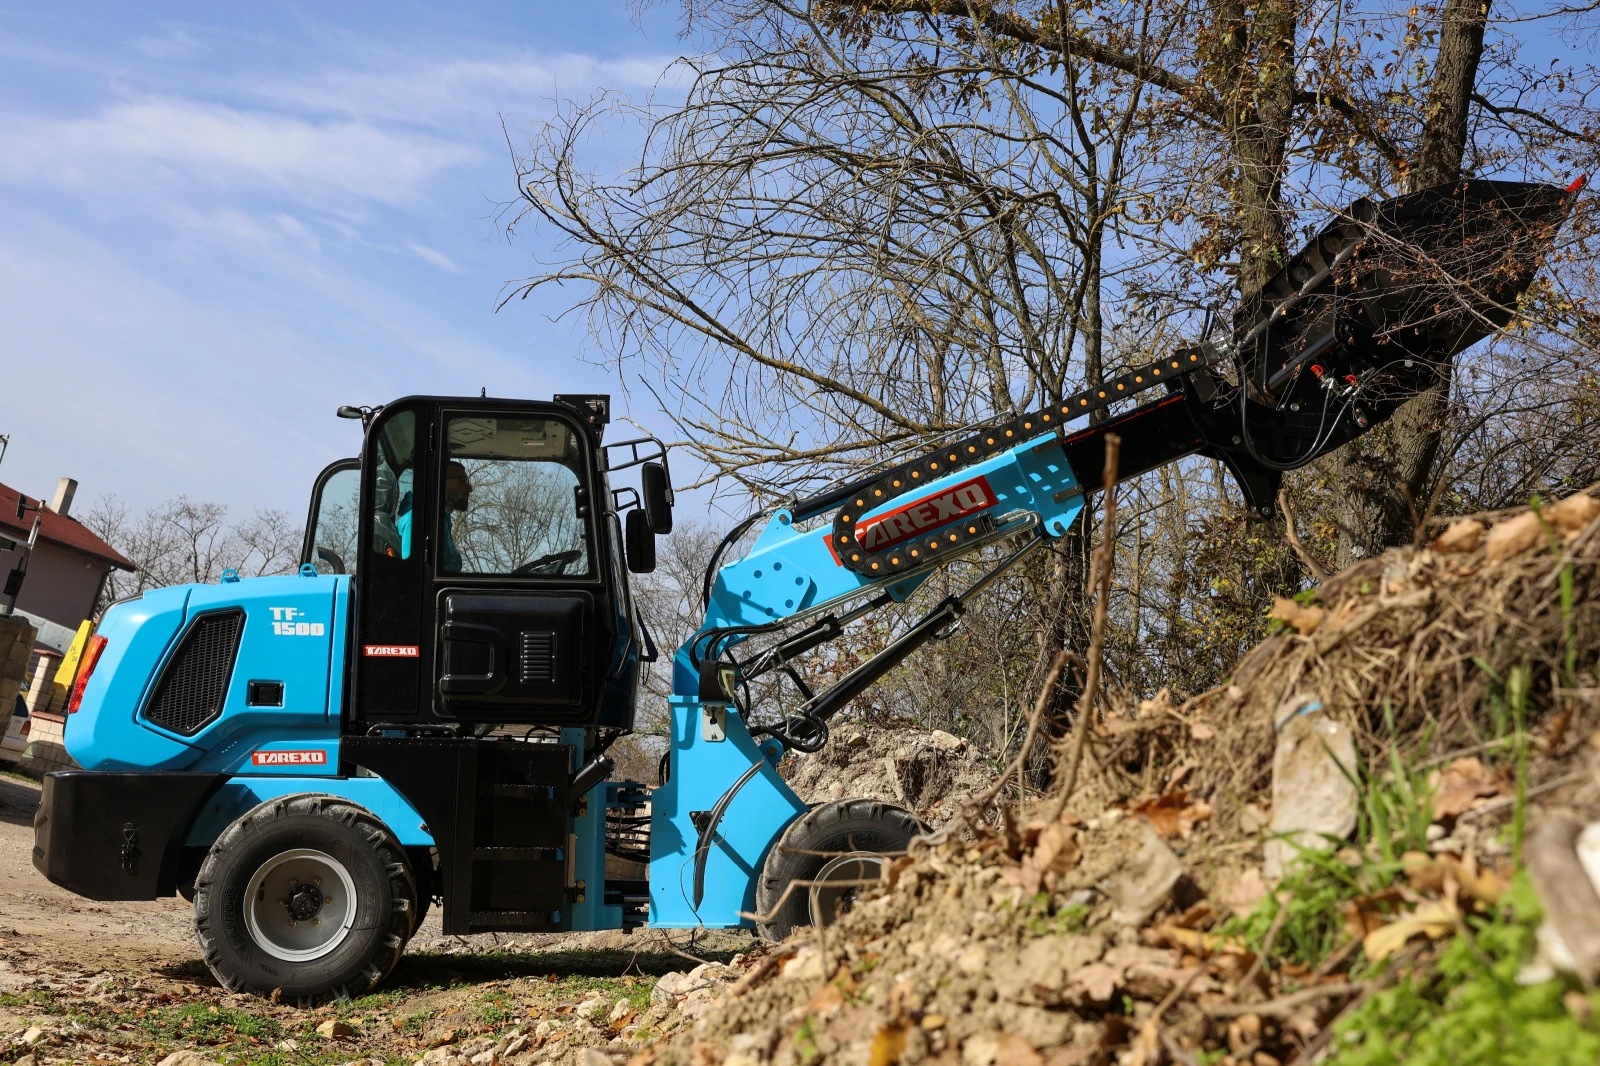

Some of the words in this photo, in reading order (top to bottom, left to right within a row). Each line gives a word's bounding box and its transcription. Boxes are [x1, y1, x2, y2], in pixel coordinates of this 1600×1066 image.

[855, 484, 988, 550] AREXO
[269, 607, 305, 620] TF-
[271, 622, 325, 636] 1500
[365, 646, 416, 656] TAREXO
[254, 752, 323, 764] TAREXO
